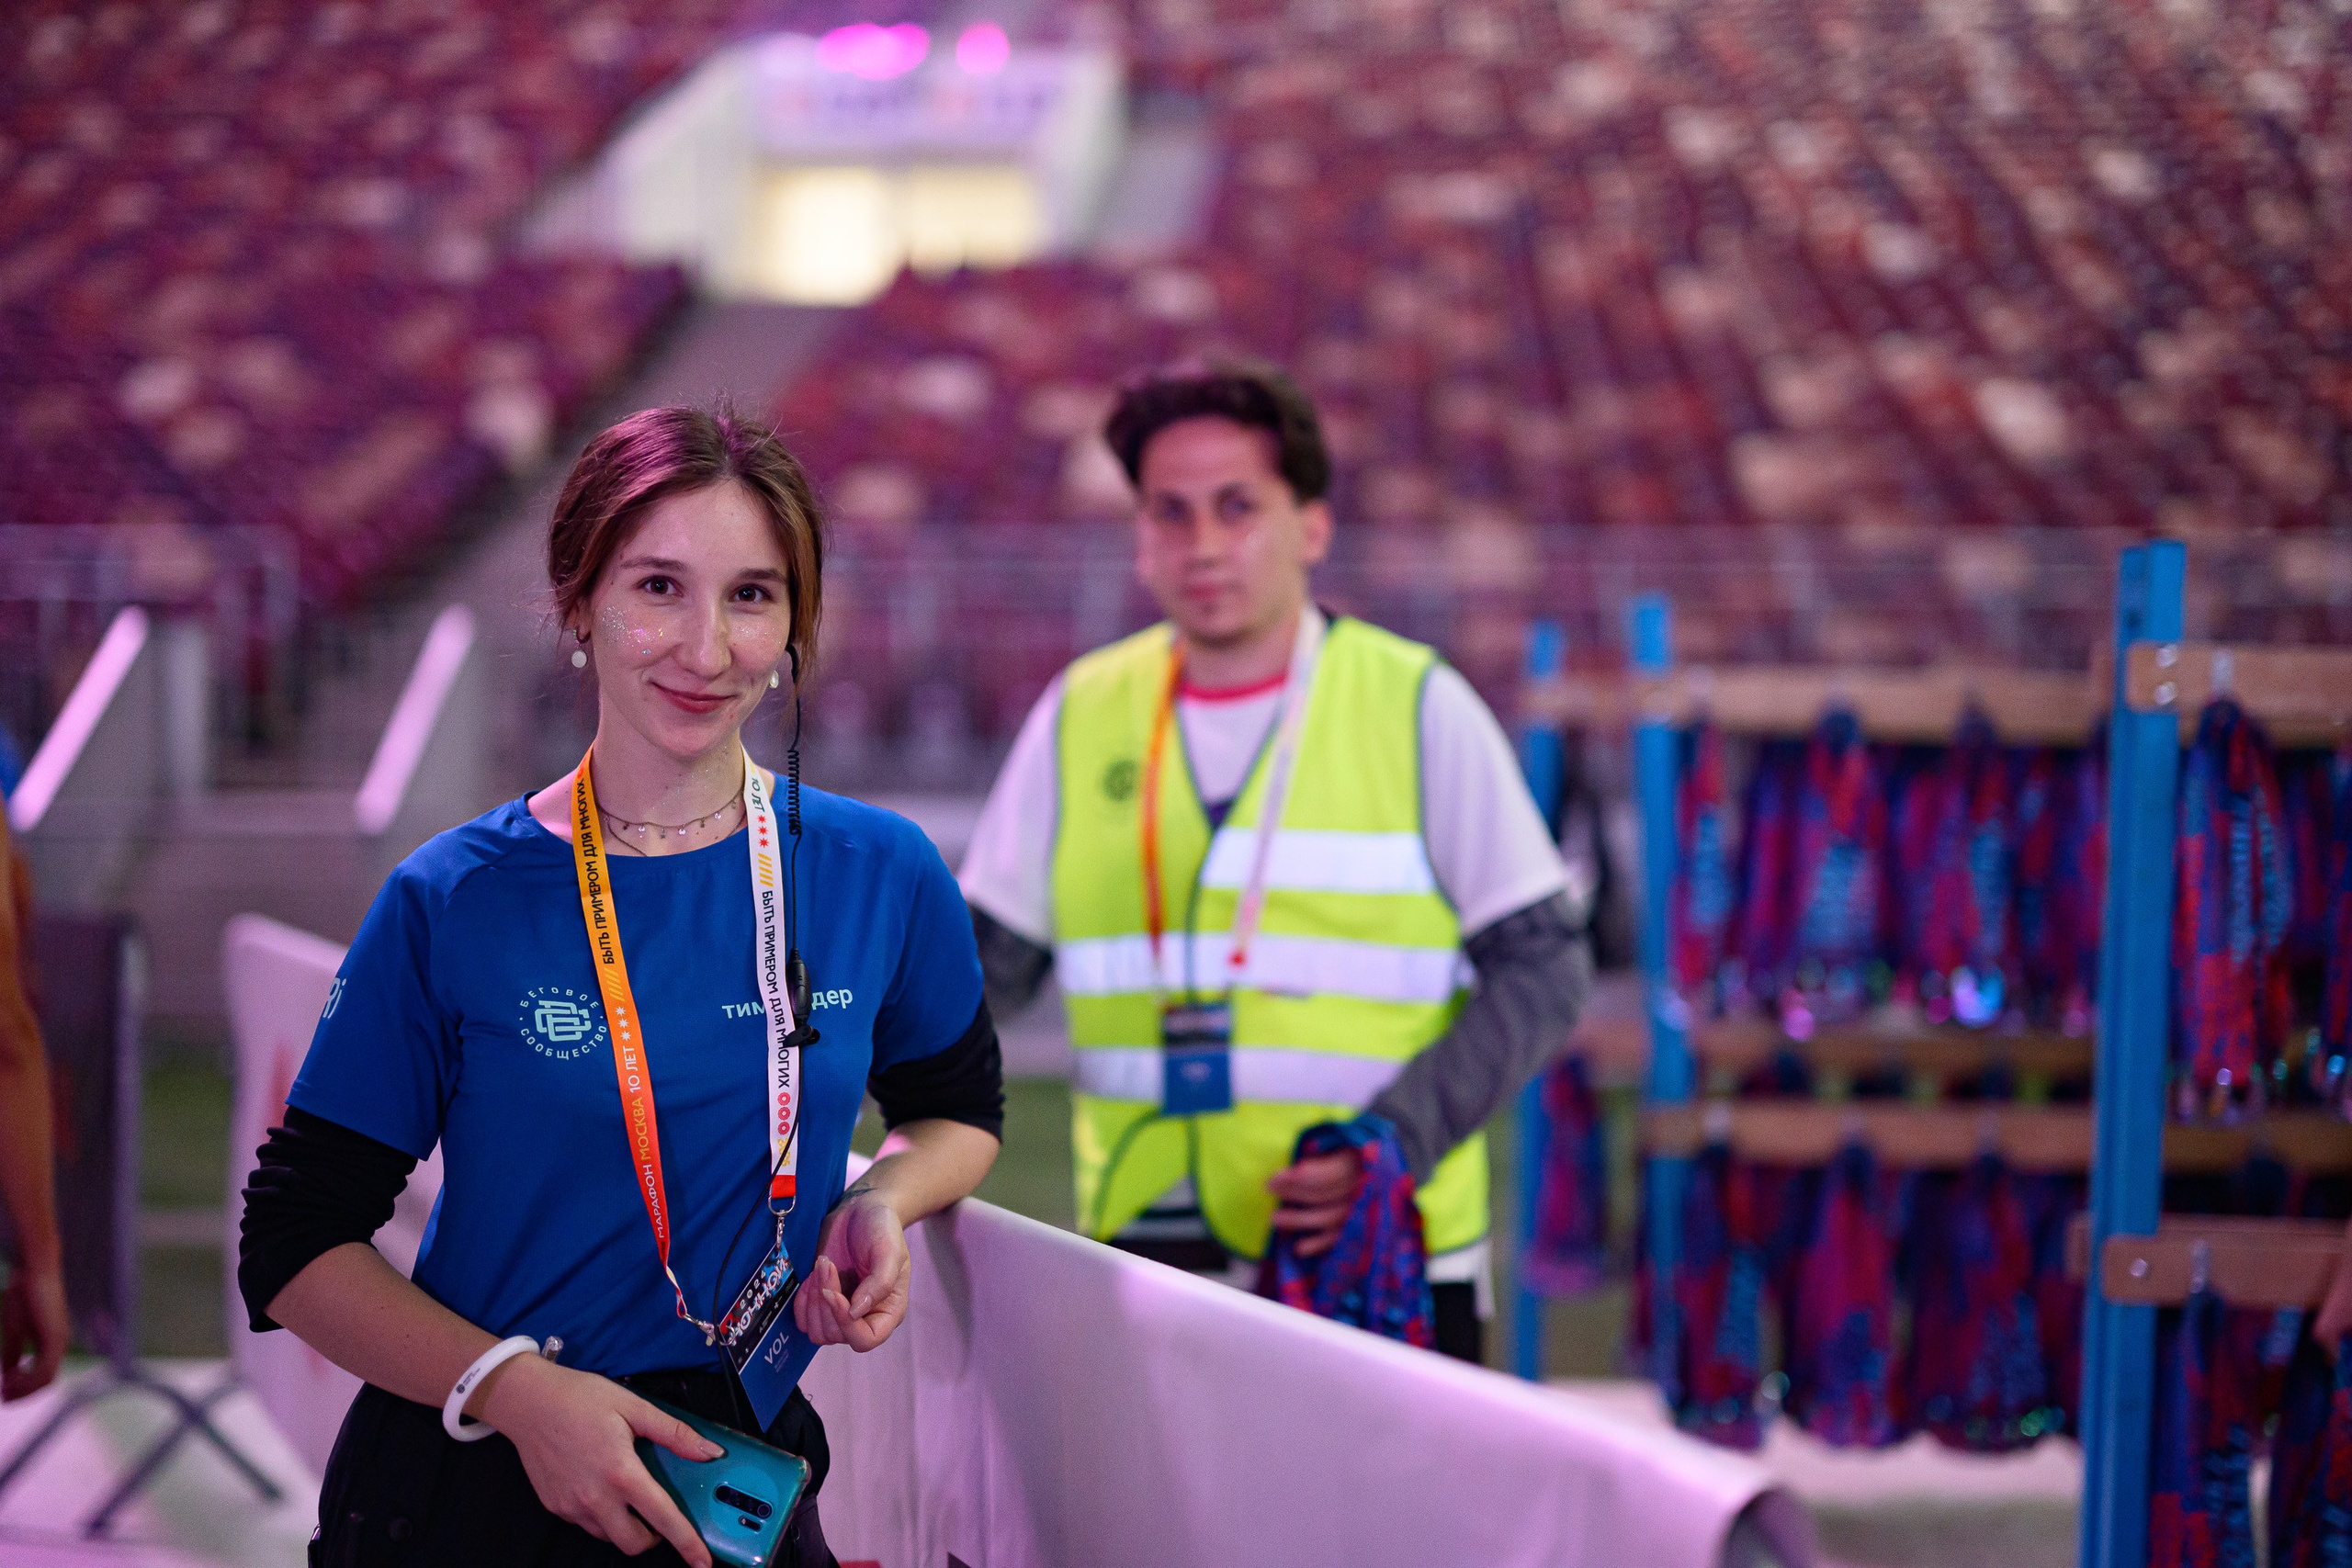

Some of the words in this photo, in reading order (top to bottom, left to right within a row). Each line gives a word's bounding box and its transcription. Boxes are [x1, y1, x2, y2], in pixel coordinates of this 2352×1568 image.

[576, 777, 592, 830] МНОГИХ
[752, 793, 766, 813] ЛЕТ
[581, 831, 598, 858] ДЛЯ
[586, 860, 608, 930] ПРИМЕРОМ
[762, 890, 775, 923] БЫТЬ
[598, 931, 615, 964] БЫТЬ
[764, 924, 779, 995] ПРИМЕРОМ
[519, 987, 600, 1009] БЕГОВОЕ
[721, 988, 854, 1020] тимдер
[769, 996, 786, 1026] ДЛЯ
[520, 1025, 607, 1060] СООБЩЕСТВО
[622, 1045, 638, 1071] ЛЕТ
[628, 1075, 641, 1093] 10
[631, 1096, 652, 1161] МОСКВА
[642, 1164, 664, 1238] МАРАФОН
[740, 1269, 766, 1310] 2024
[763, 1332, 789, 1364] VOL
